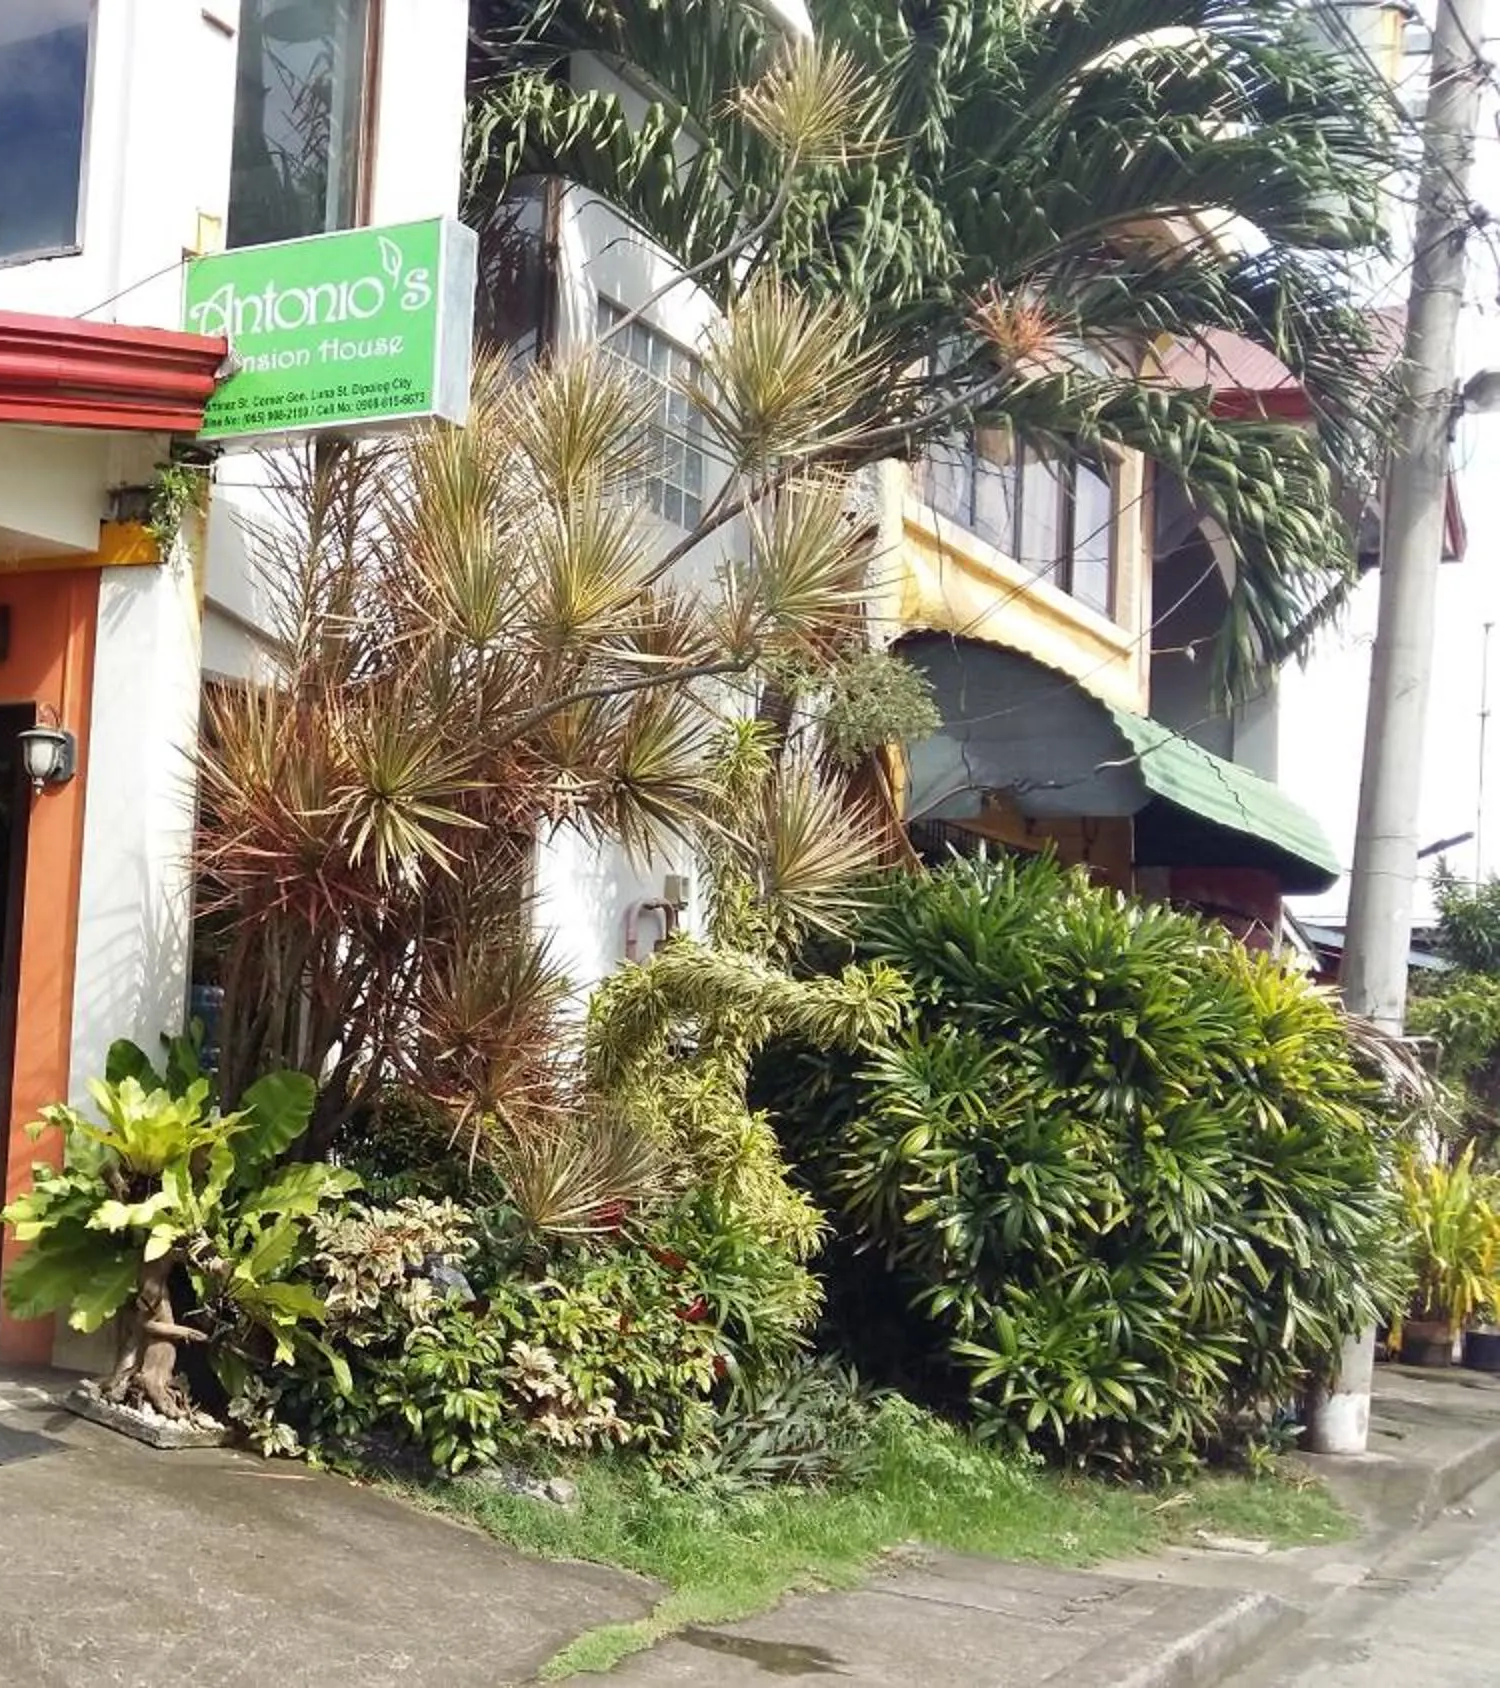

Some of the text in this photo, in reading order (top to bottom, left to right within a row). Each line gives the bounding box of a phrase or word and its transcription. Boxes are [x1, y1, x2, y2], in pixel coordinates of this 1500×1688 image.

[190, 236, 432, 335] Antonio's
[242, 335, 404, 374] nsion House
[392, 377, 412, 390] City
